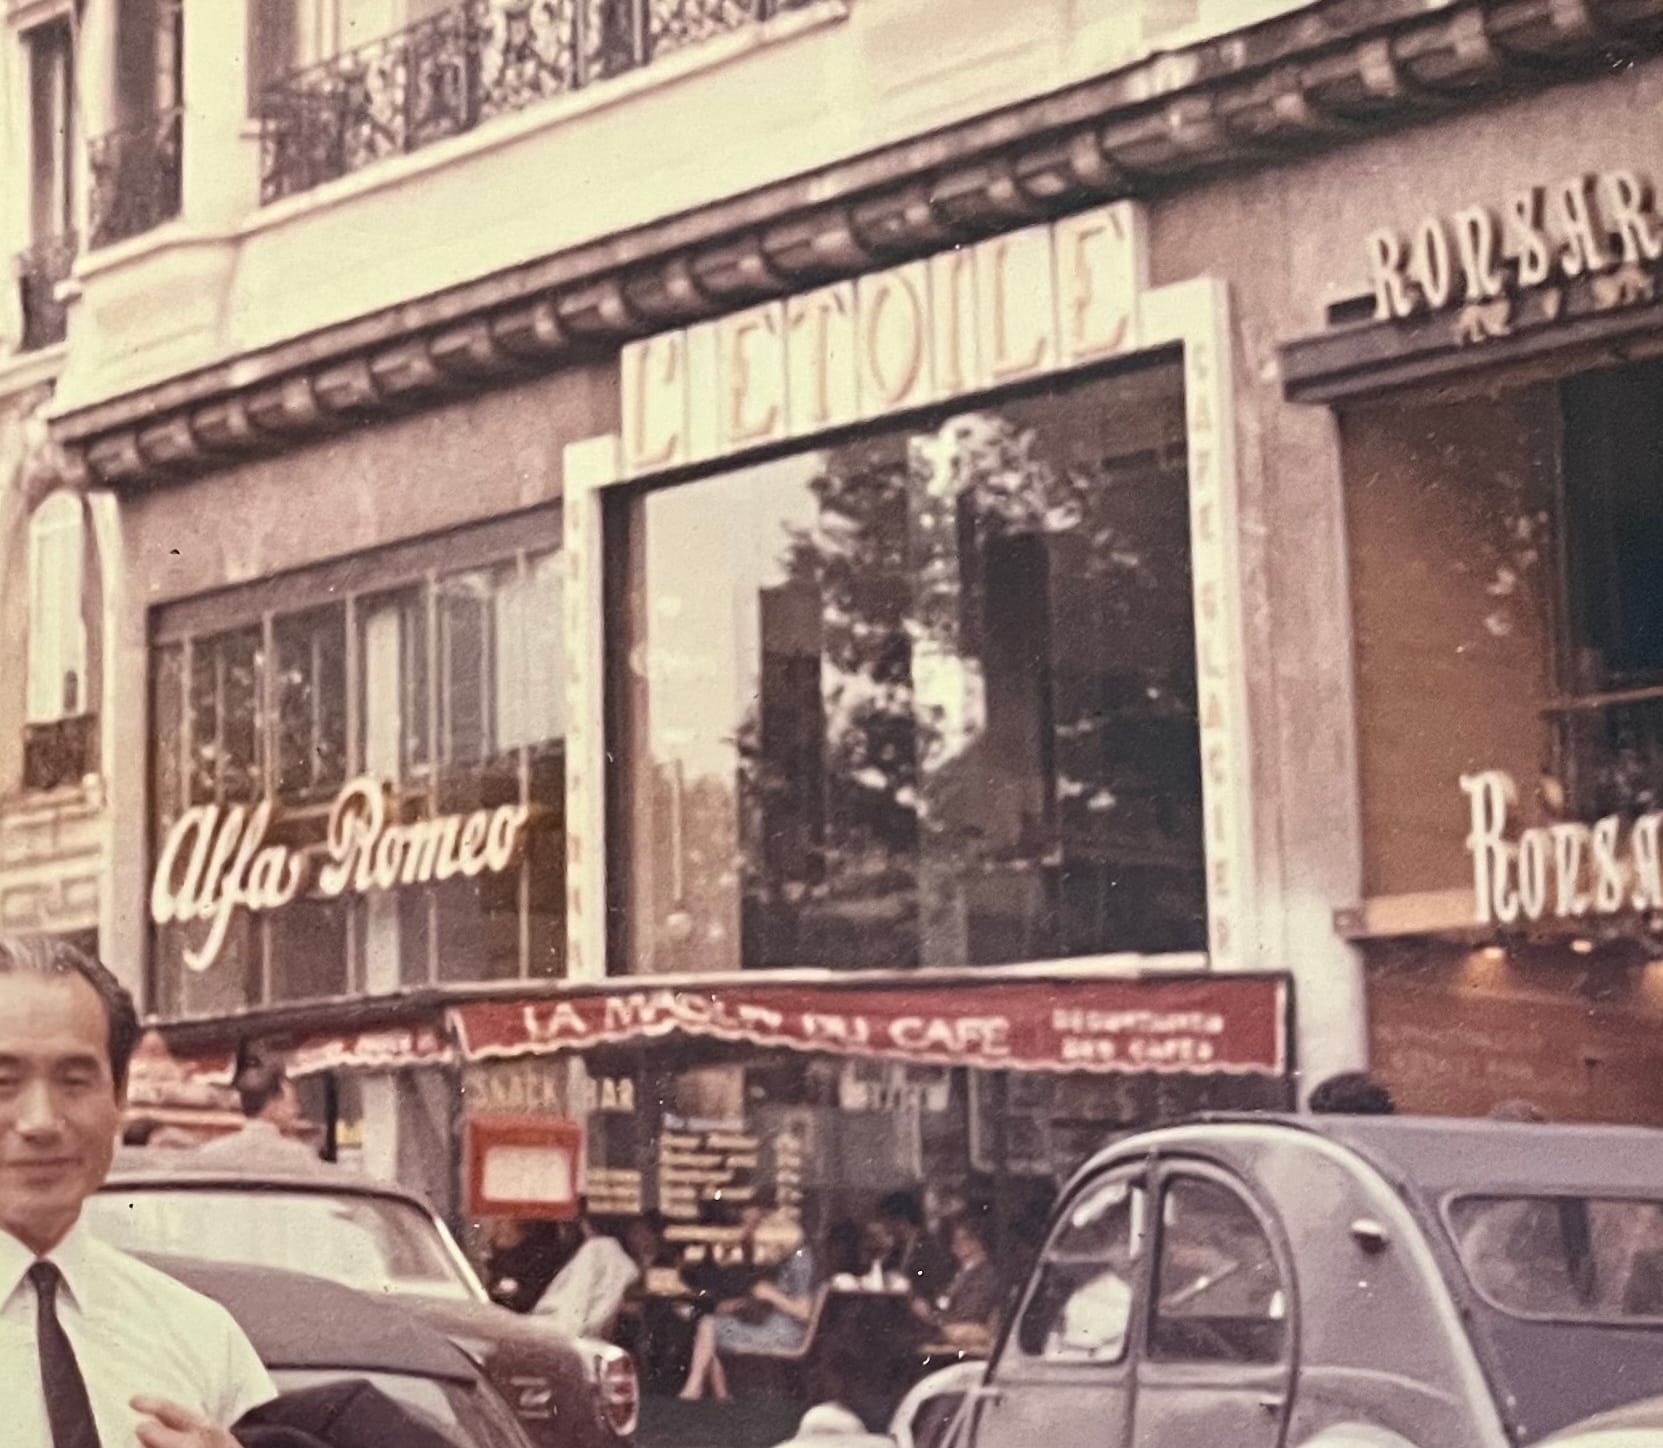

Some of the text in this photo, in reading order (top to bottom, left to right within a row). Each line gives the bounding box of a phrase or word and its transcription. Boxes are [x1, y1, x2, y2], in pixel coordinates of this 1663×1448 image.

[150, 777, 529, 973] Alfa Romeo
[523, 1002, 588, 1038] LA
